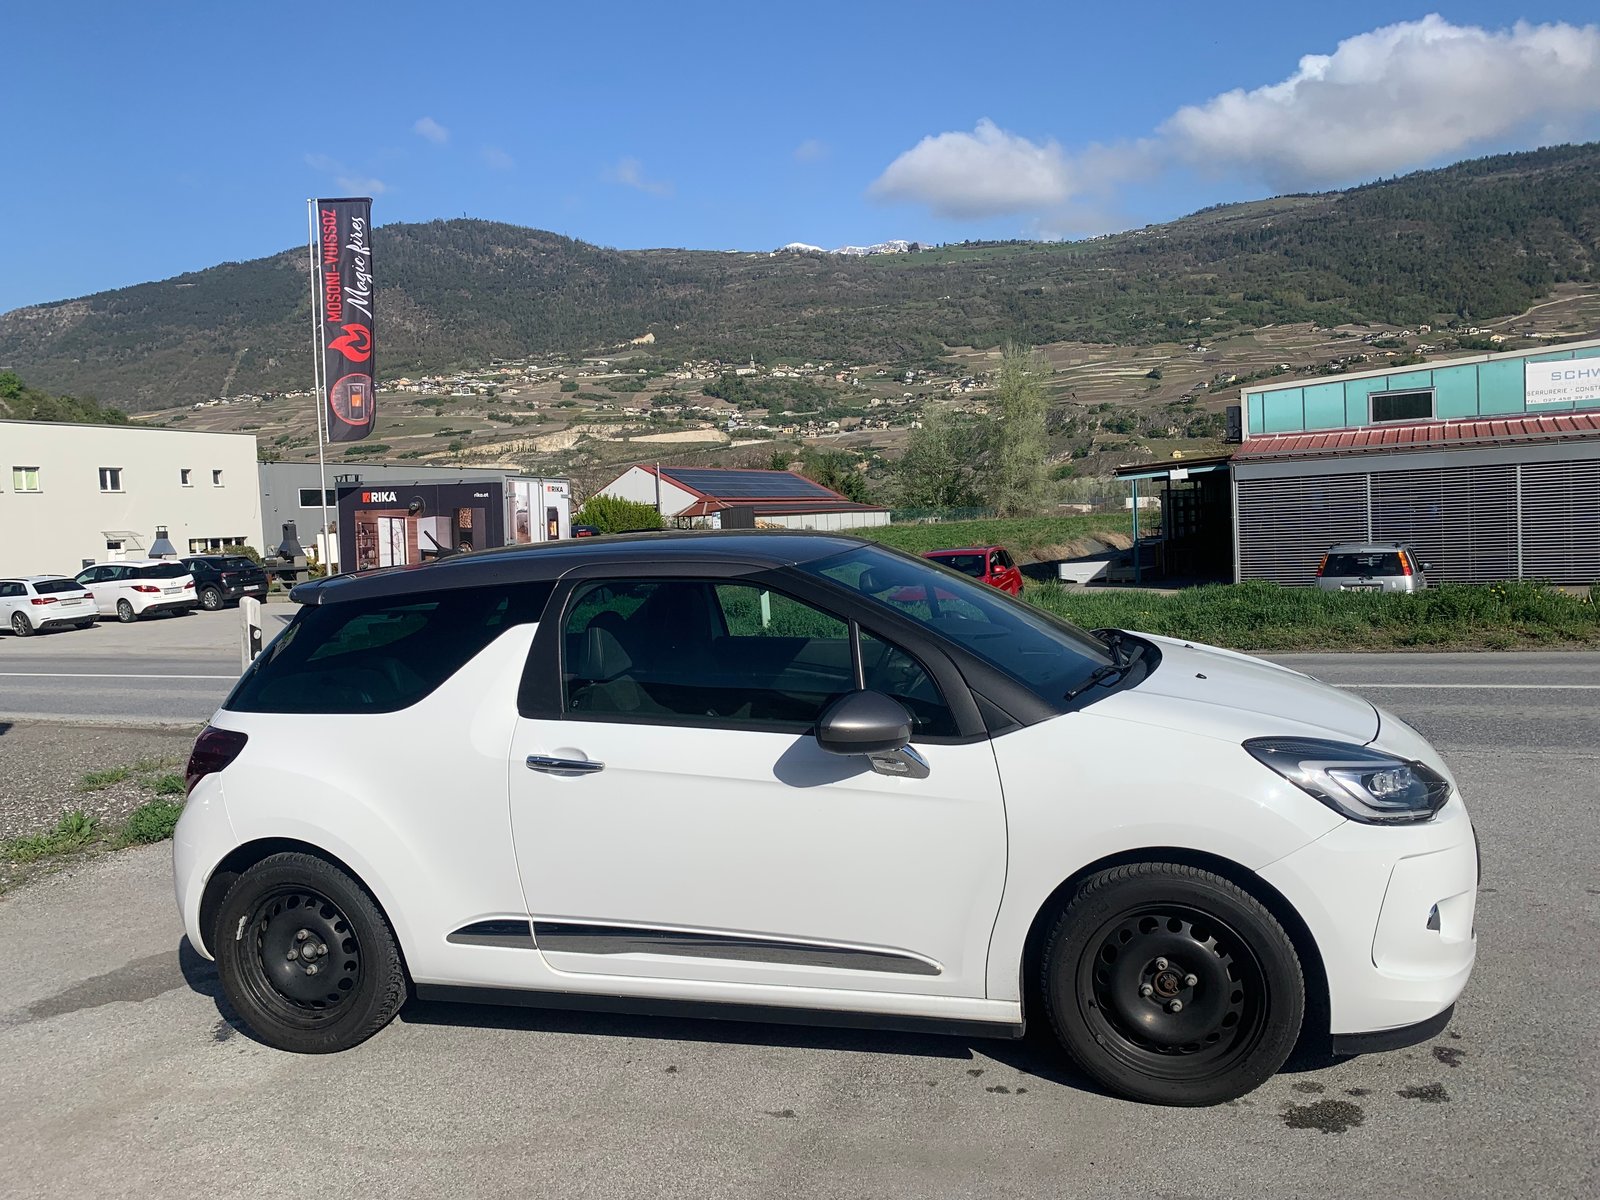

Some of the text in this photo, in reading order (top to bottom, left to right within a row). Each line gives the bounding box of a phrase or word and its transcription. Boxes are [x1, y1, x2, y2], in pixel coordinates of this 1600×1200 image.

[322, 209, 342, 322] MOSONI-VUISSOZ
[344, 216, 373, 320] Magic fires
[1527, 388, 1568, 396] SERRURERIE
[551, 485, 564, 493] RIKA
[371, 491, 397, 503] RIKA
